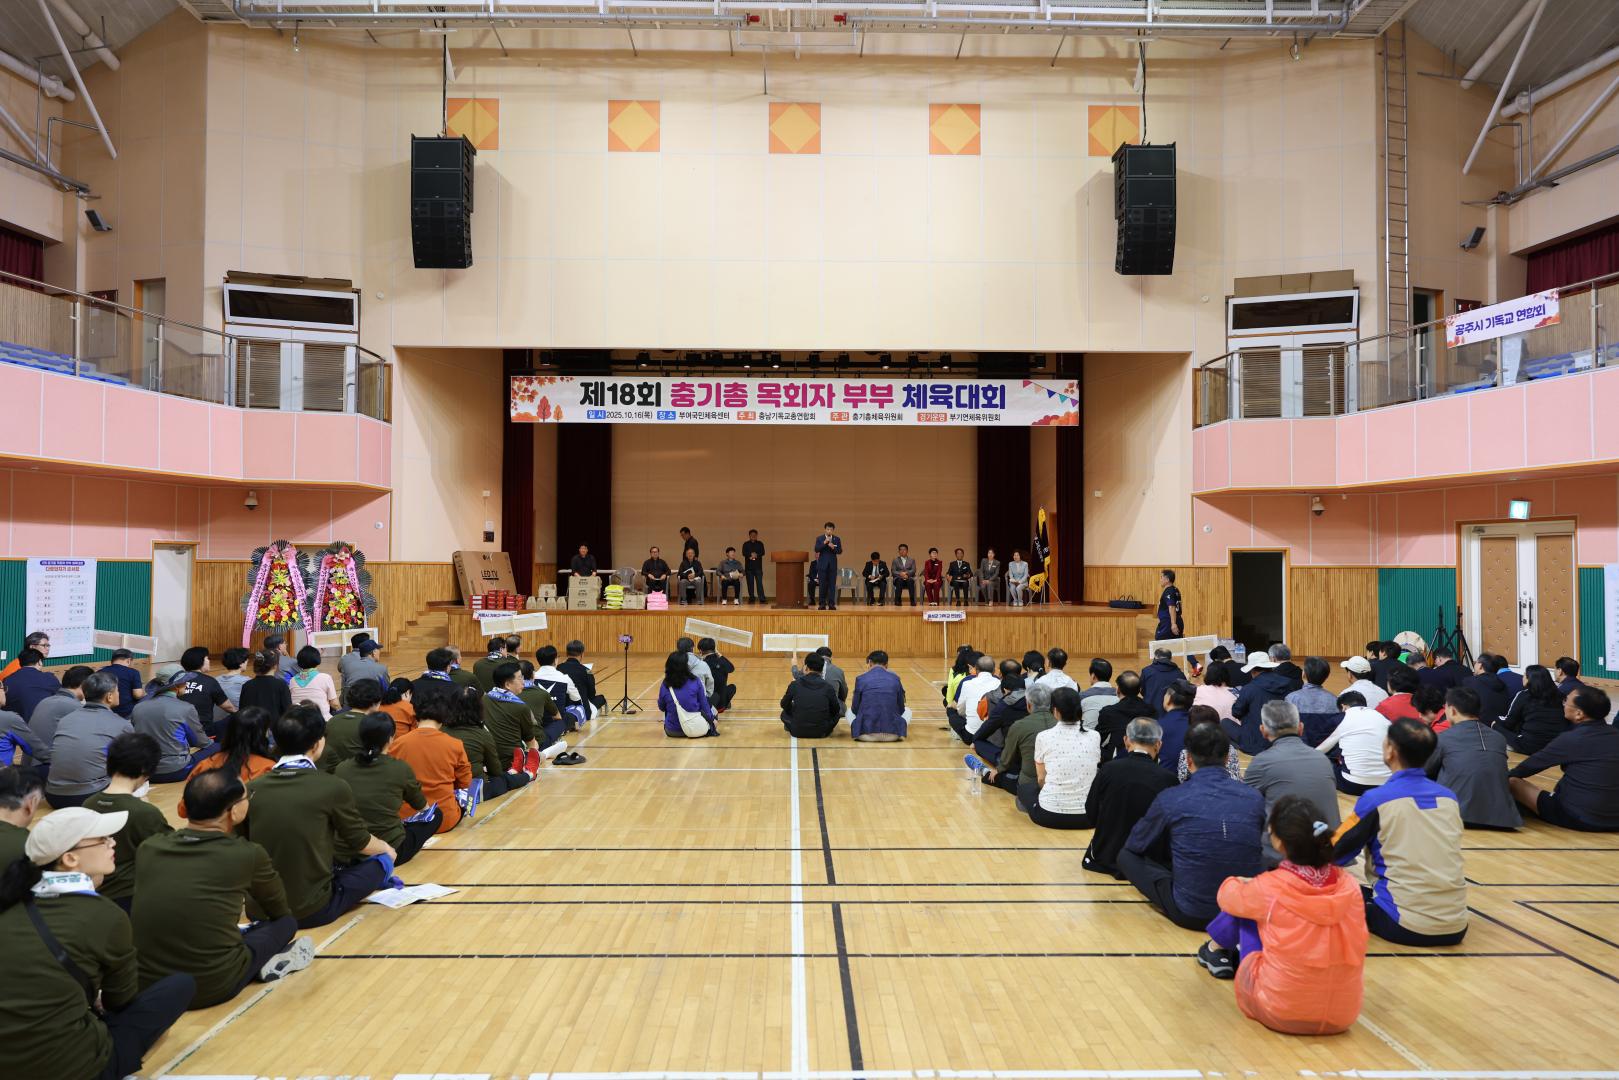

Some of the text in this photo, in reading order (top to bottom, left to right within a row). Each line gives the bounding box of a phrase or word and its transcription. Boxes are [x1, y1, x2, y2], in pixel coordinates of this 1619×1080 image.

[1455, 303, 1546, 336] 공주시 기독교 연합회
[579, 381, 1006, 410] 제18회 충기총 목회자 부부 체육대회
[606, 411, 653, 420] 2025.10.16(목)
[678, 411, 730, 421] 부여국민체육센터
[481, 569, 491, 578] LED
